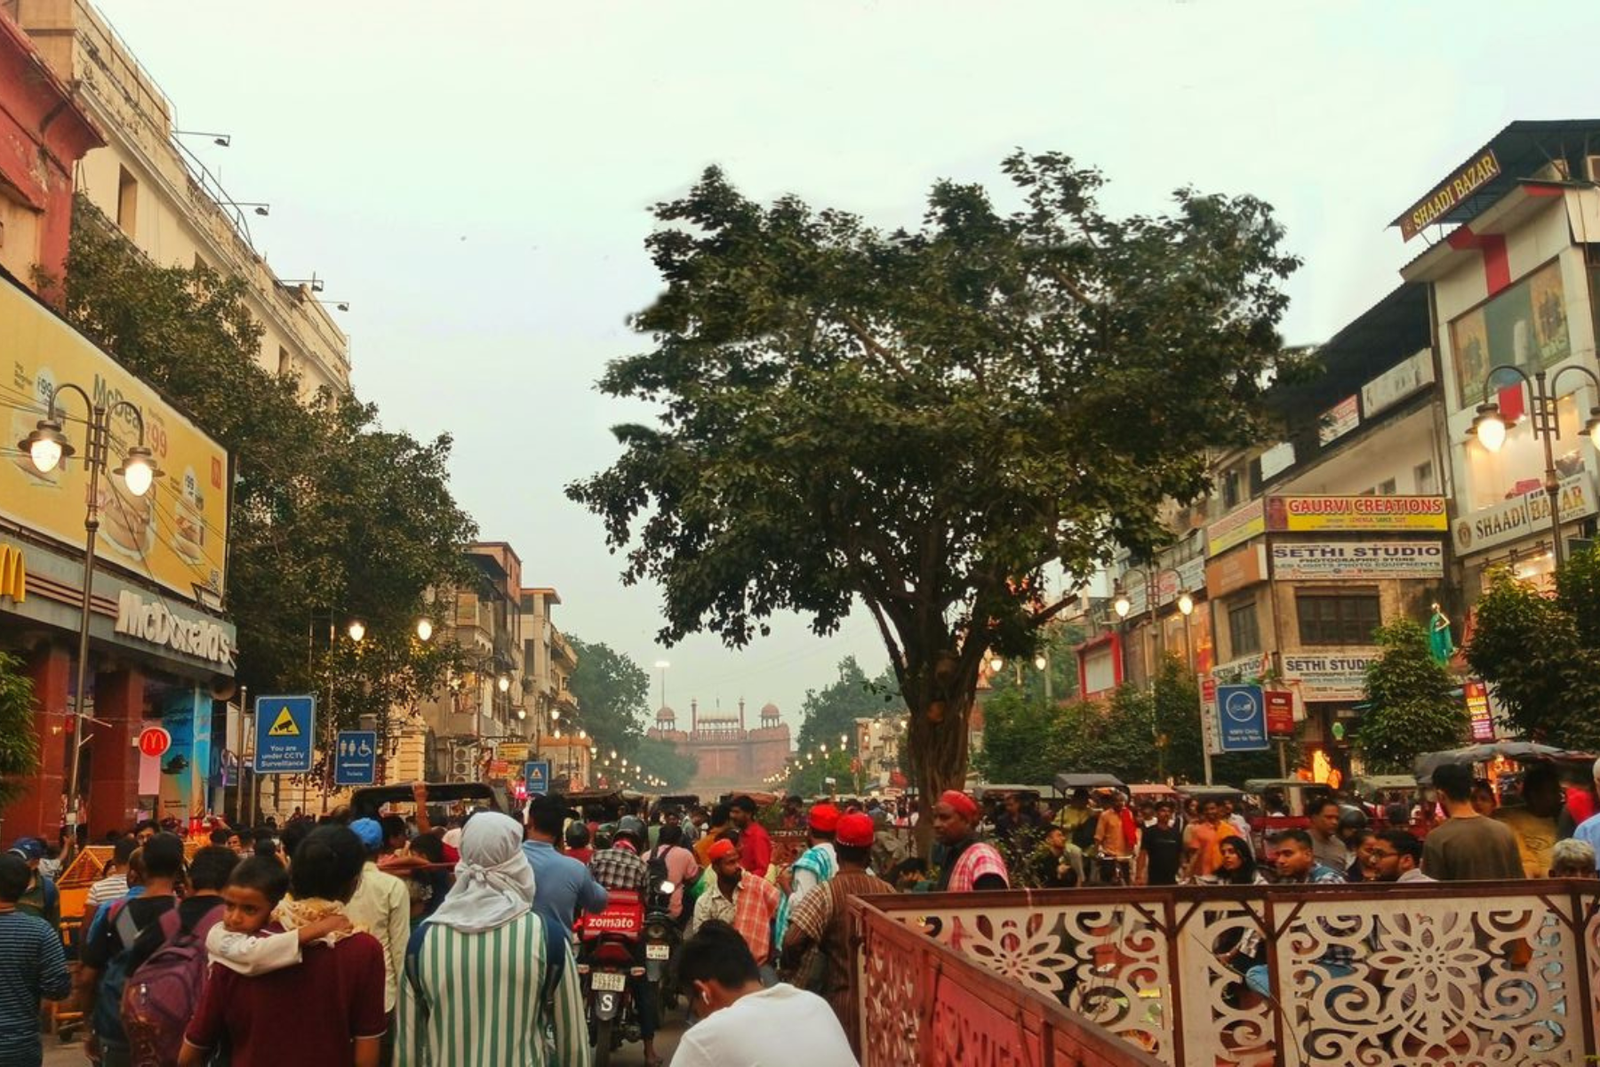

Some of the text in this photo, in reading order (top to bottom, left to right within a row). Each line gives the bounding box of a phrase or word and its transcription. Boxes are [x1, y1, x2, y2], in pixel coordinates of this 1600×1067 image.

[1412, 156, 1497, 230] SHAADI BAZAR
[1288, 498, 1444, 515] GAURVI CREATIONS
[1475, 486, 1586, 540] SHAADI BAAR
[1274, 546, 1441, 558] SETHI STUDIO
[115, 589, 231, 664] McDonald's
[1238, 659, 1262, 672] STUD
[1286, 659, 1369, 671] SETHI STUD
[261, 760, 305, 768] Surveillance
[588, 917, 635, 929] zomato
[600, 994, 614, 1012] S
